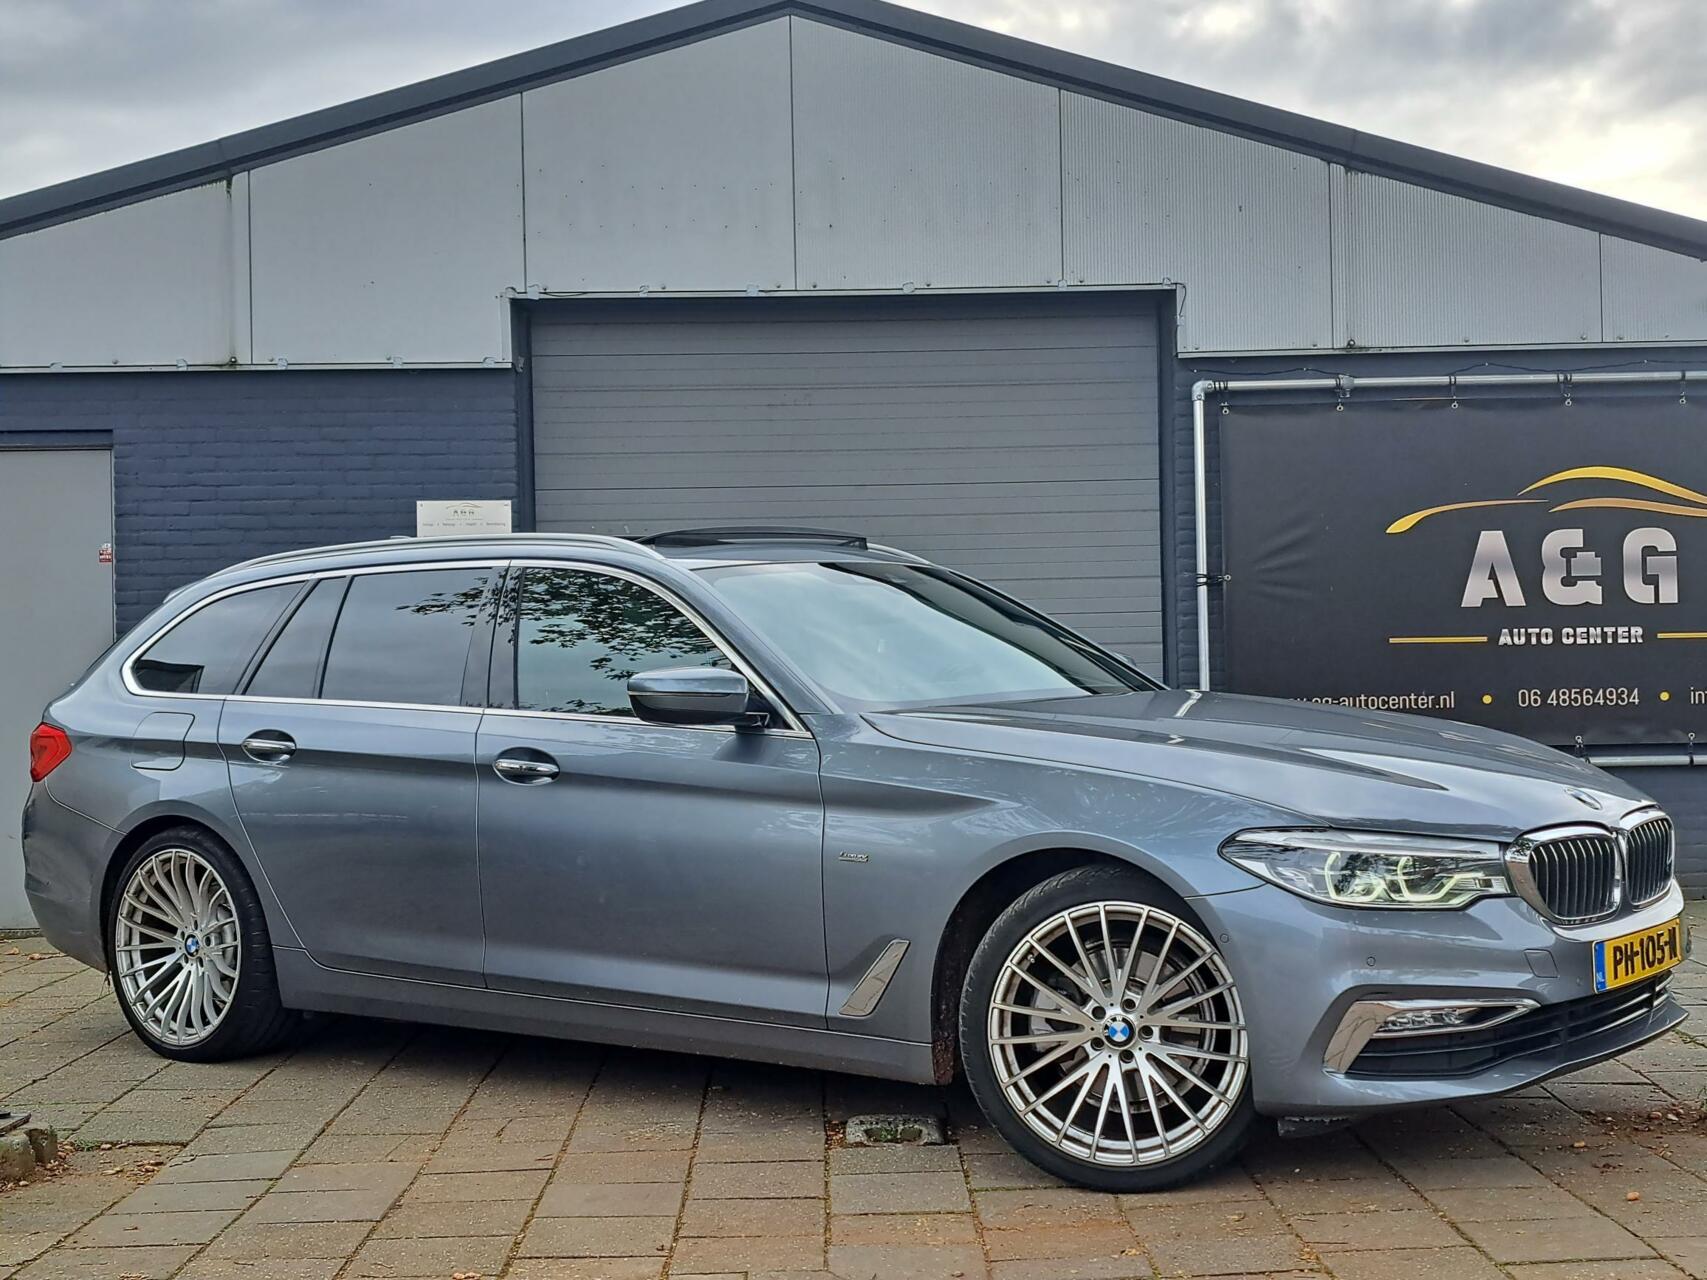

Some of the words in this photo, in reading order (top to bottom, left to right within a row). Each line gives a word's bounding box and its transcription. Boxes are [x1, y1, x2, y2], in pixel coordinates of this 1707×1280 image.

[1498, 628, 1553, 645] AUTO
[1561, 626, 1643, 645] CENTER
[1518, 689, 1541, 707] 06
[1547, 687, 1640, 707] 48564934
[1690, 686, 1707, 704] in
[1613, 927, 1677, 980] PH-105-N
